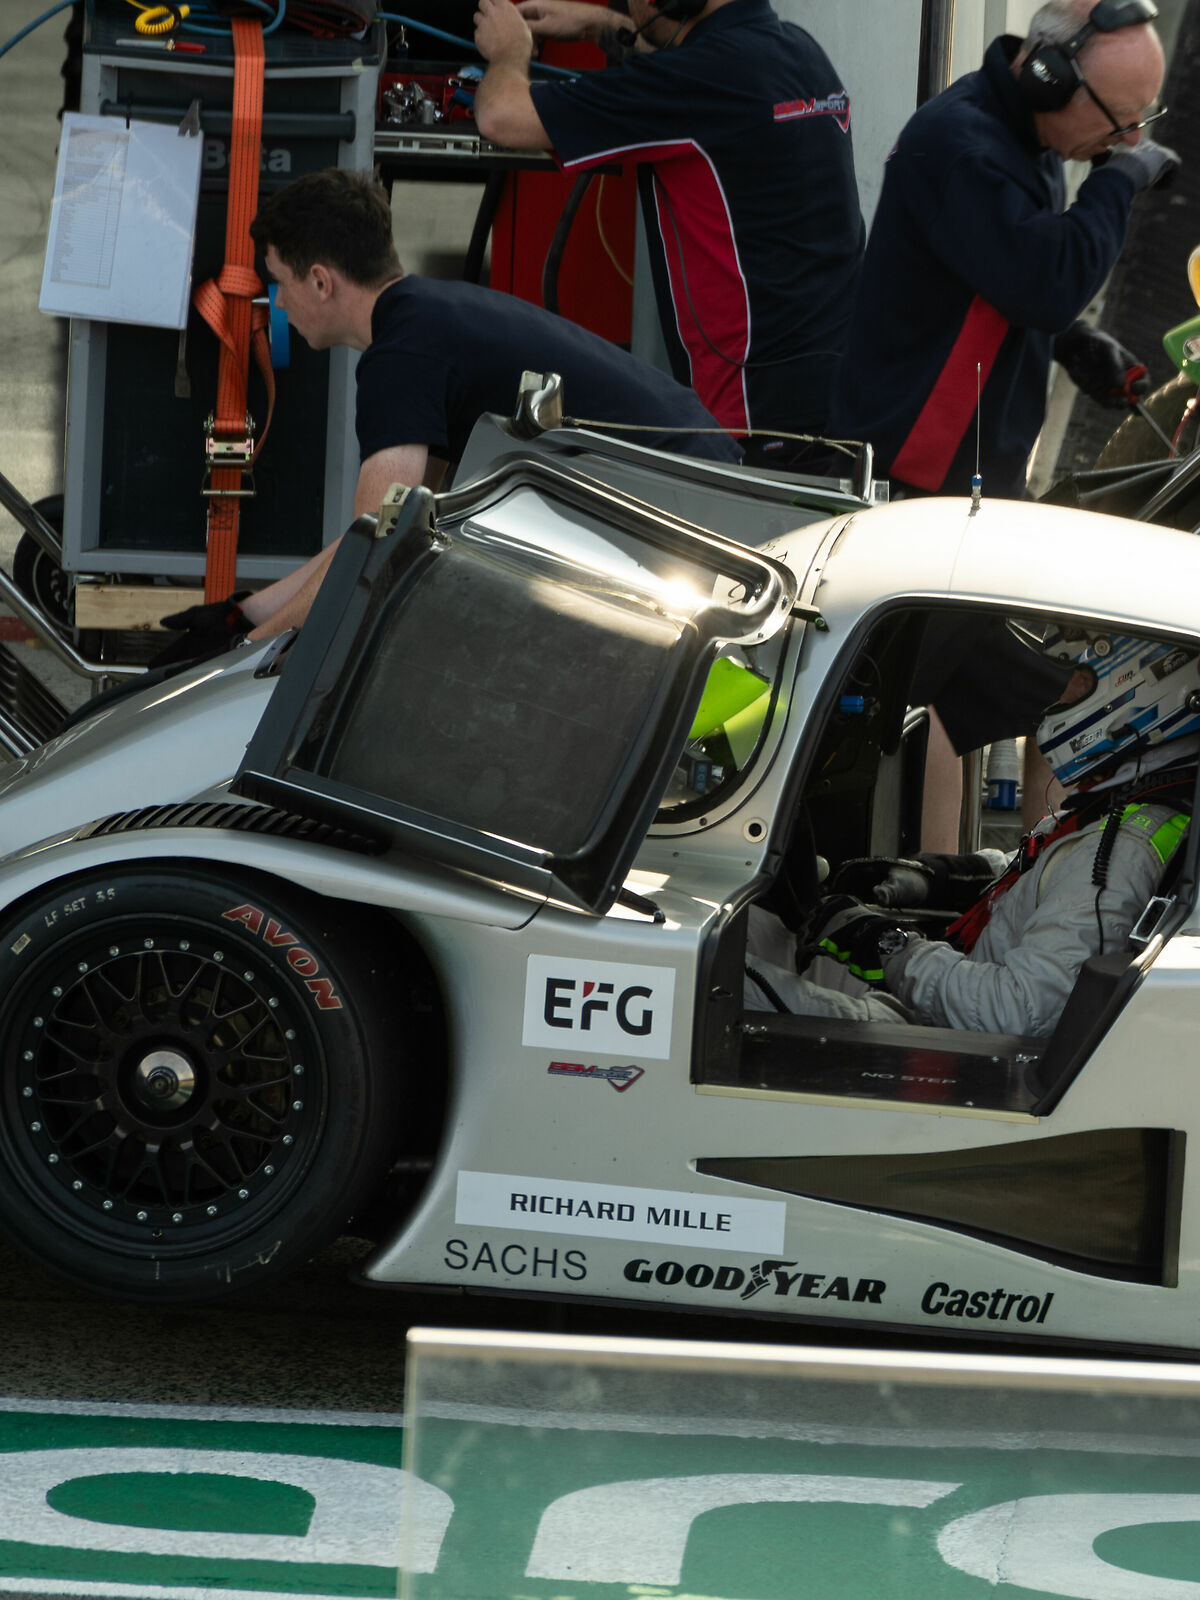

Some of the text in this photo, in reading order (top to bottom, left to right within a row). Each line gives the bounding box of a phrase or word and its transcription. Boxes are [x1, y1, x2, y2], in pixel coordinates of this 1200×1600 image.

[203, 142, 292, 172] Bta
[220, 903, 343, 1011] AVON
[544, 977, 653, 1037] EFG
[860, 1071, 957, 1085] NO STEP
[510, 1192, 732, 1233] RICHARD MILLE
[444, 1239, 588, 1281] SACHS
[623, 1258, 887, 1305] GOODYEAR
[921, 1281, 1054, 1325] Castrol
